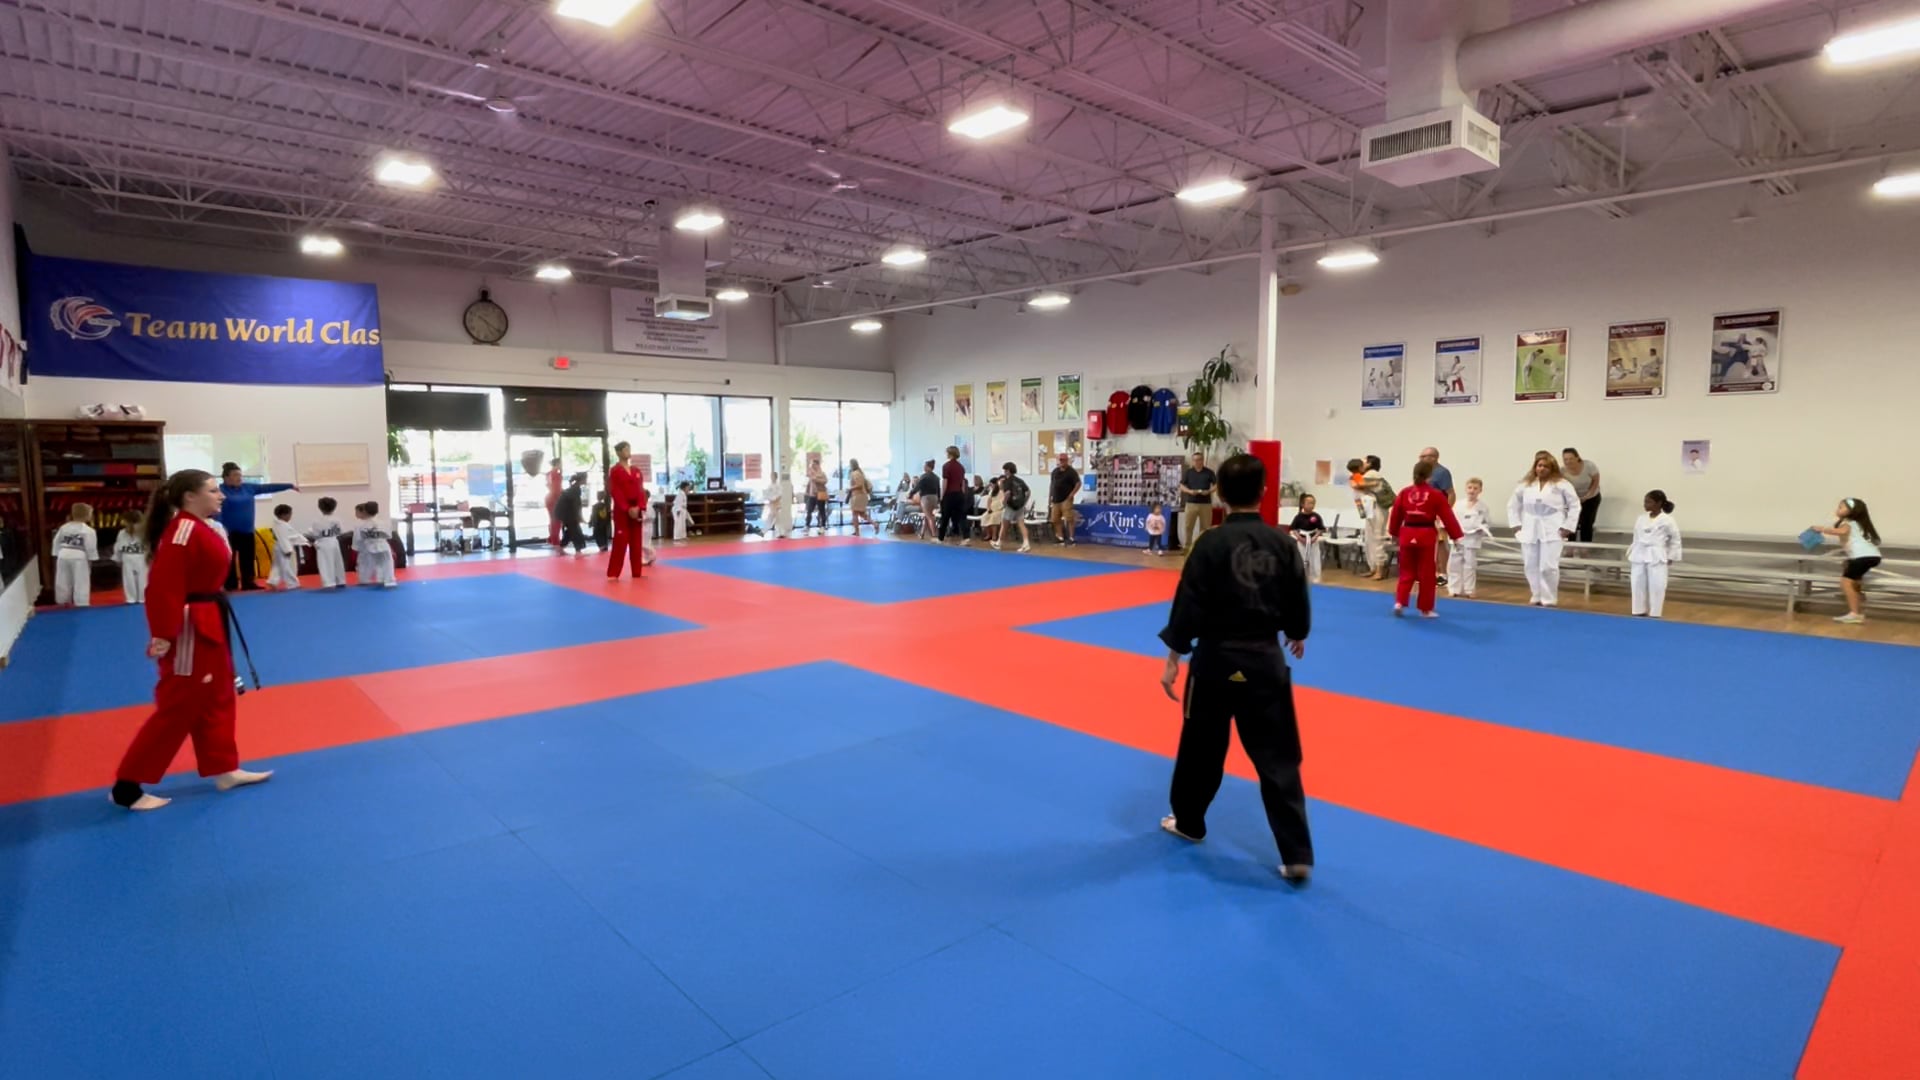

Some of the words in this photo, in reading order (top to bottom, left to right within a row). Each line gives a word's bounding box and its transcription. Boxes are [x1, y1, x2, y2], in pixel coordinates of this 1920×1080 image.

[125, 312, 218, 341] Team
[224, 317, 314, 344] World
[320, 321, 381, 346] Clas
[1103, 511, 1145, 535] Kim's
